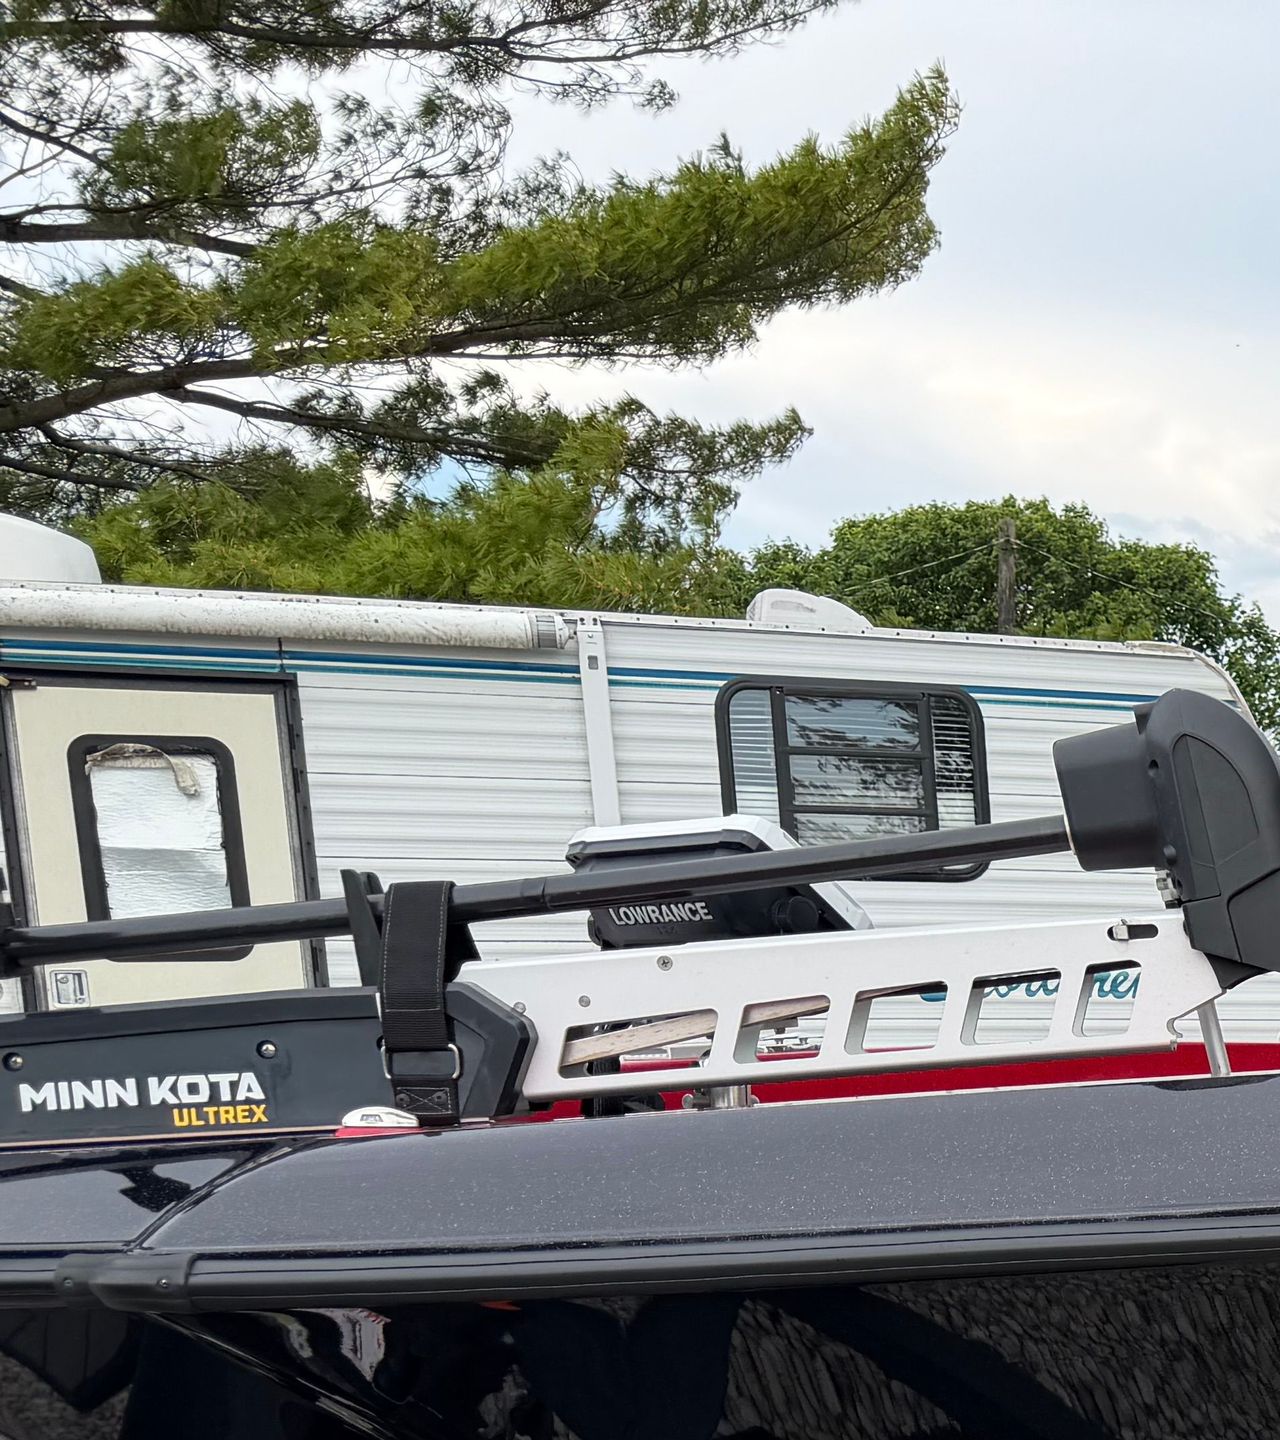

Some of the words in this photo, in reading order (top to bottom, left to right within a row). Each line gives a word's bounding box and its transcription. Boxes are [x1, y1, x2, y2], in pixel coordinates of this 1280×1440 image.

[608, 902, 713, 926] LOWRANCE
[19, 1078, 139, 1112] MINN
[148, 1072, 266, 1105] KOTA
[173, 1104, 268, 1127] ULTREX
